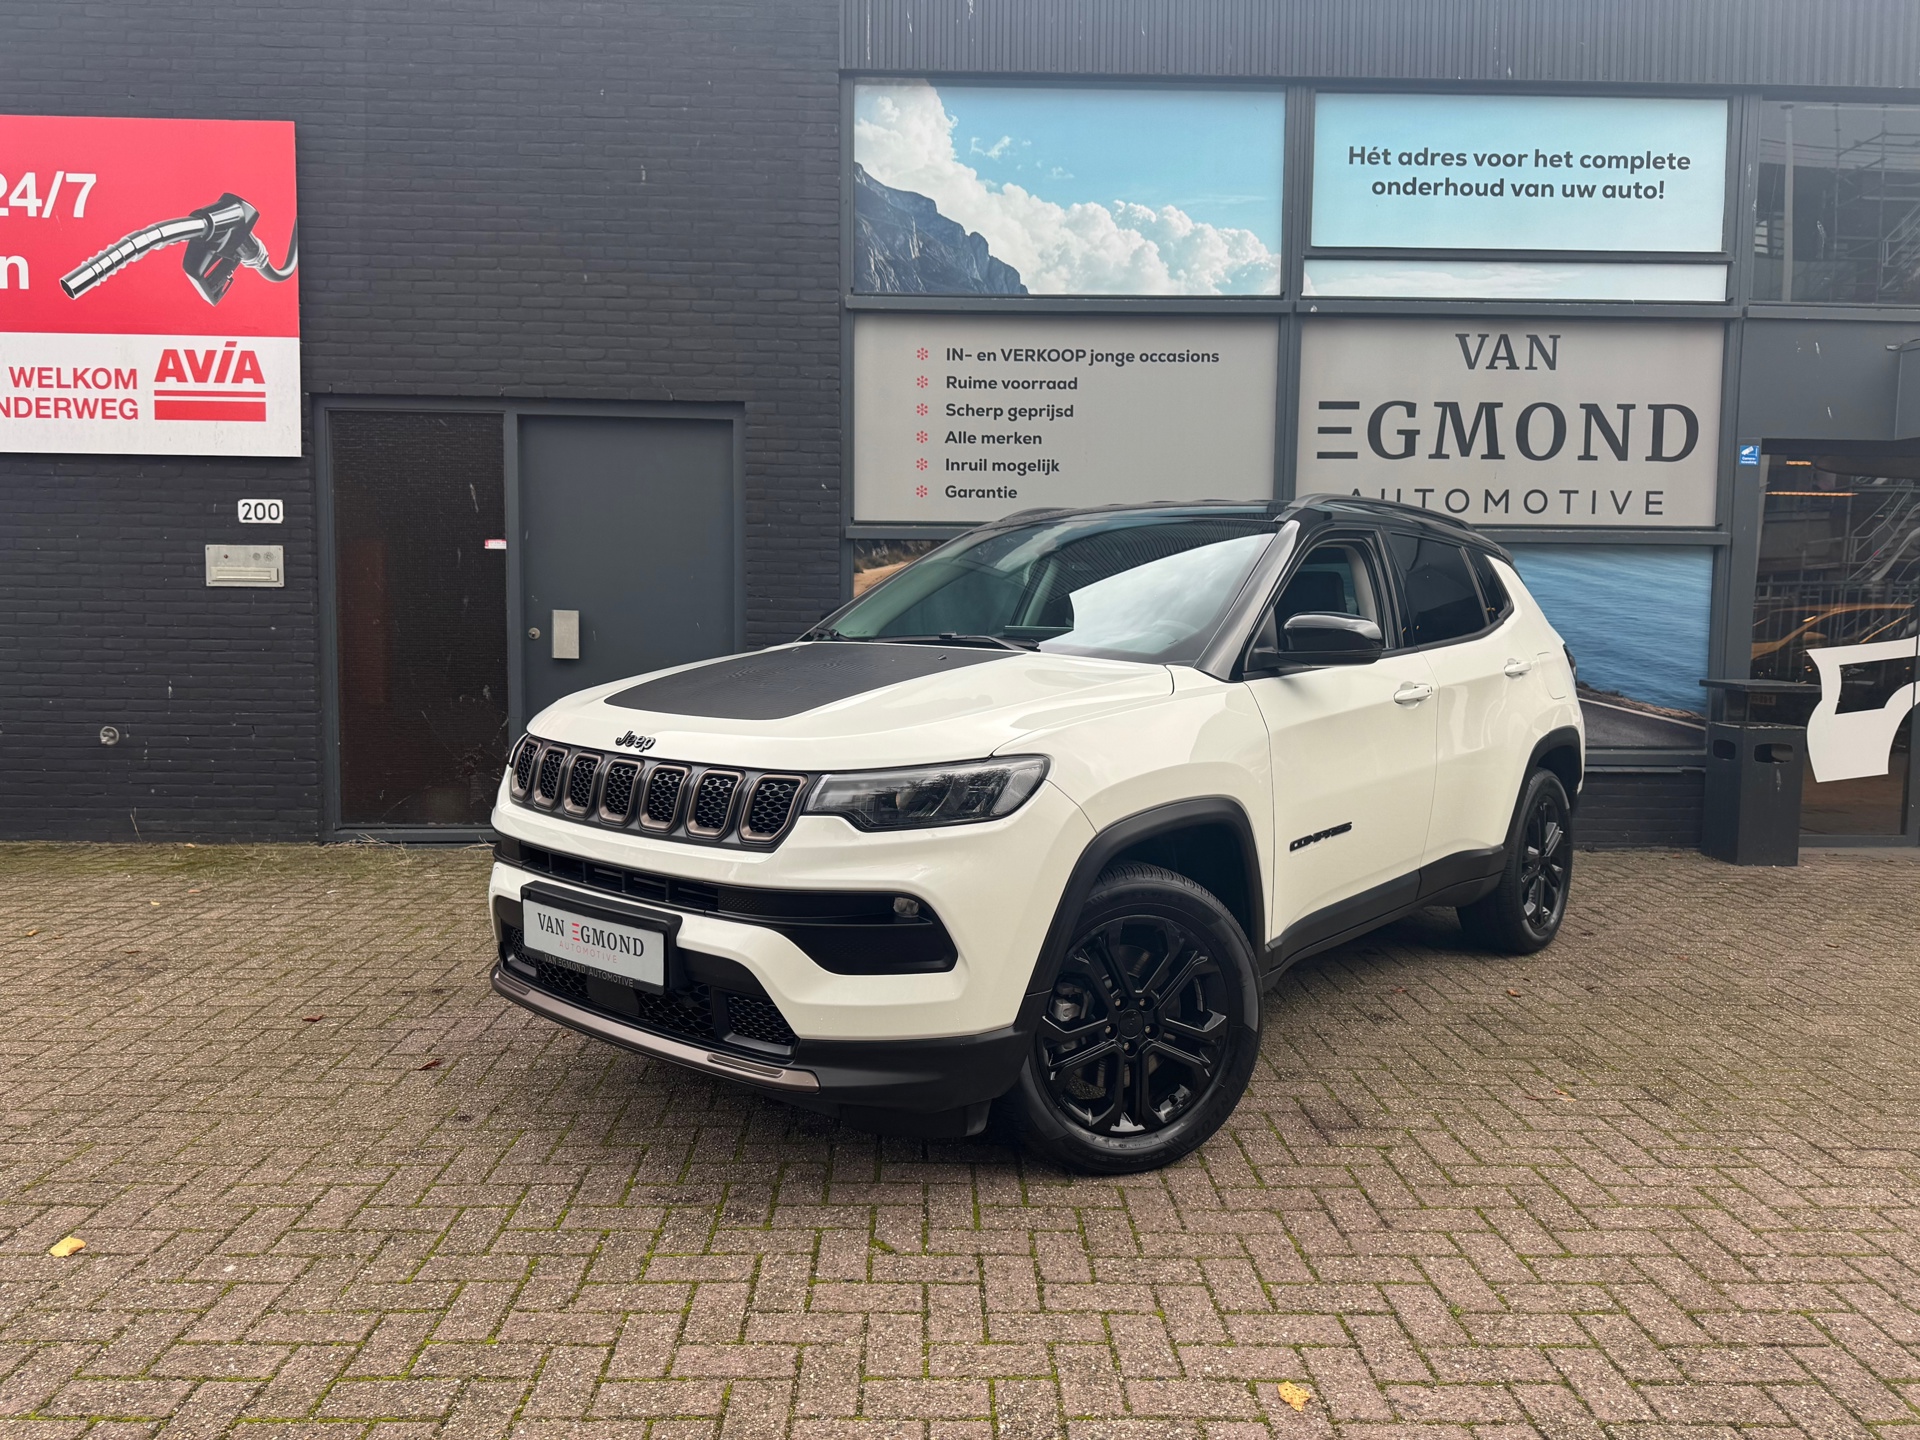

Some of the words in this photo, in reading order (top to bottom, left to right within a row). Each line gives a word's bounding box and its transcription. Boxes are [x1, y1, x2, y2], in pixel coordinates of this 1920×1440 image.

[1348, 145, 1392, 165] Hét
[1397, 147, 1467, 166] adres
[1473, 151, 1528, 167] voor
[1534, 149, 1573, 168] het
[1579, 151, 1691, 174] complete
[0, 171, 97, 218] 4/7
[1371, 177, 1504, 197] onderhoud
[1511, 182, 1555, 197] van
[1562, 182, 1597, 198] uw
[1602, 181, 1665, 199] auto!
[945, 348, 973, 362] IN-
[976, 351, 997, 362] en
[1000, 349, 1086, 362] VERKOOP
[1089, 350, 1135, 367] jonge
[1139, 350, 1219, 363] occasions
[1455, 333, 1561, 370] VAN
[8, 366, 138, 390] WELKOM
[945, 376, 998, 389] Ruime
[1001, 377, 1078, 390] voorraad
[945, 403, 1004, 420] Scherp
[1007, 404, 1074, 421] geprijsd
[944, 431, 977, 444] Alle
[981, 431, 1042, 445] merken
[1316, 400, 1699, 462] EGMOND
[945, 458, 988, 472] Inruil
[991, 459, 1060, 476] mogelijk
[945, 485, 1018, 499] Garantie
[241, 502, 280, 520] 200
[615, 730, 656, 753] Jeep
[537, 912, 565, 937] VAN
[571, 922, 645, 957] EGMOND
[559, 940, 618, 964] AUTOMOTIVE
[544, 954, 557, 964] VAN
[558, 958, 586, 974] EGMOND
[588, 968, 634, 988] AUTOMOTIVE
